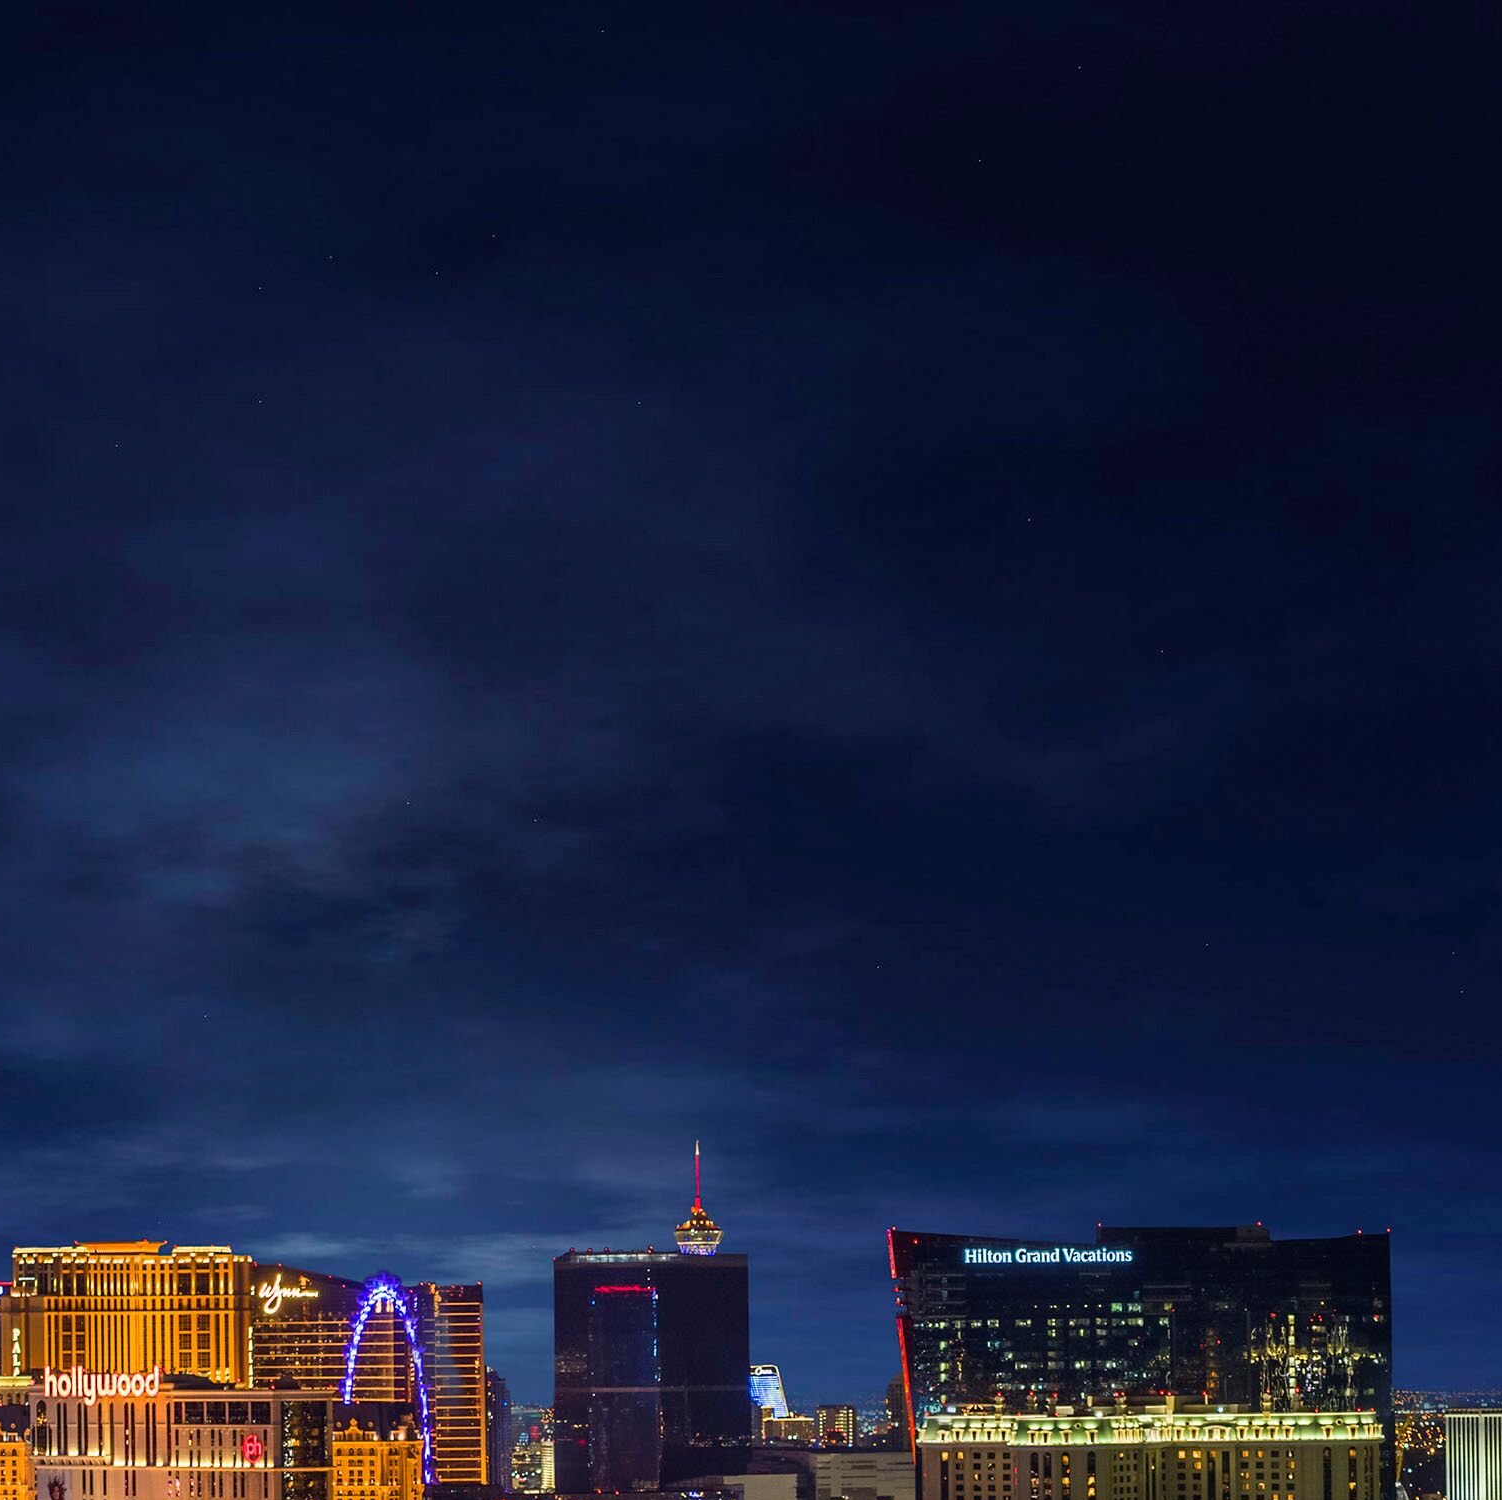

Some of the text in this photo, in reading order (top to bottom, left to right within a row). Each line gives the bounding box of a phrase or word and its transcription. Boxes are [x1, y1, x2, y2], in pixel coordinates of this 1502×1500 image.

[964, 1248, 1133, 1264] Hilton Grand Vacations
[44, 1365, 160, 1406] hollywood
